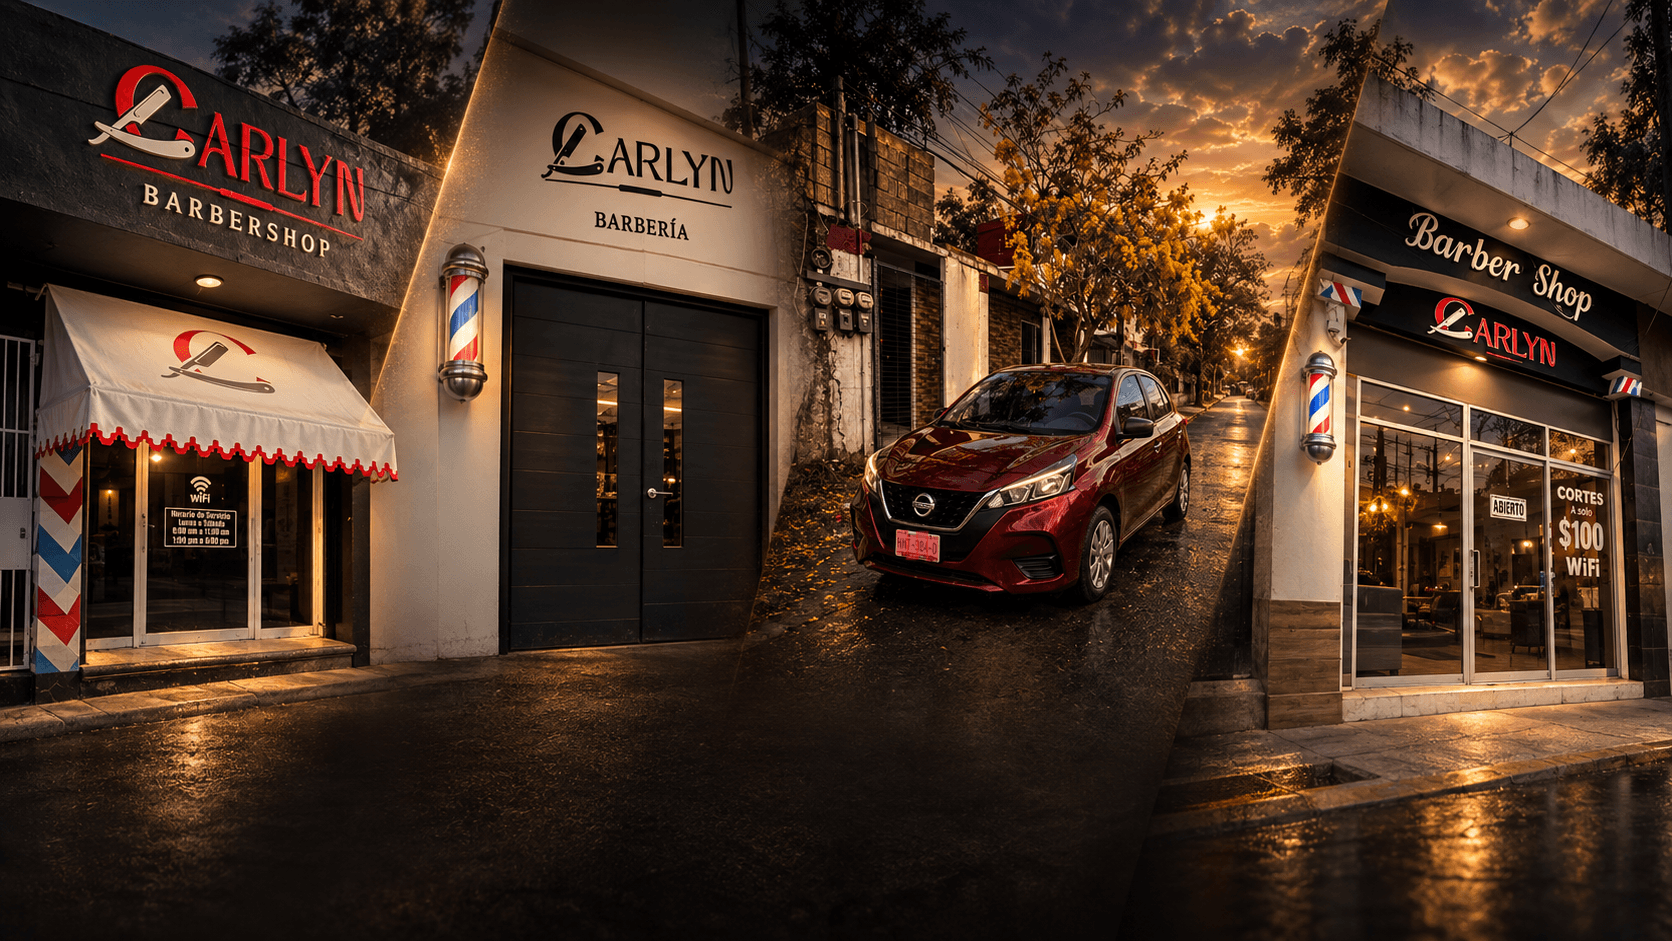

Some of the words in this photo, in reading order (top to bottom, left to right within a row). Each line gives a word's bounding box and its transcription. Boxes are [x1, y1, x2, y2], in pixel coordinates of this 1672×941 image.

[88, 64, 364, 223] CARLYN
[540, 111, 734, 195] CARLYN
[143, 183, 330, 258] BARBERSHOP
[594, 211, 689, 241] BARBERÍA
[1405, 212, 1521, 281] Barber
[1533, 264, 1592, 321] Shop
[1427, 297, 1556, 367] CARLYN
[1493, 500, 1525, 516] ABIERTO
[1557, 486, 1604, 506] CORTES
[1570, 506, 1577, 514] A
[1577, 507, 1593, 517] solo
[1559, 516, 1604, 551] $100
[1566, 556, 1600, 577] WiFi
